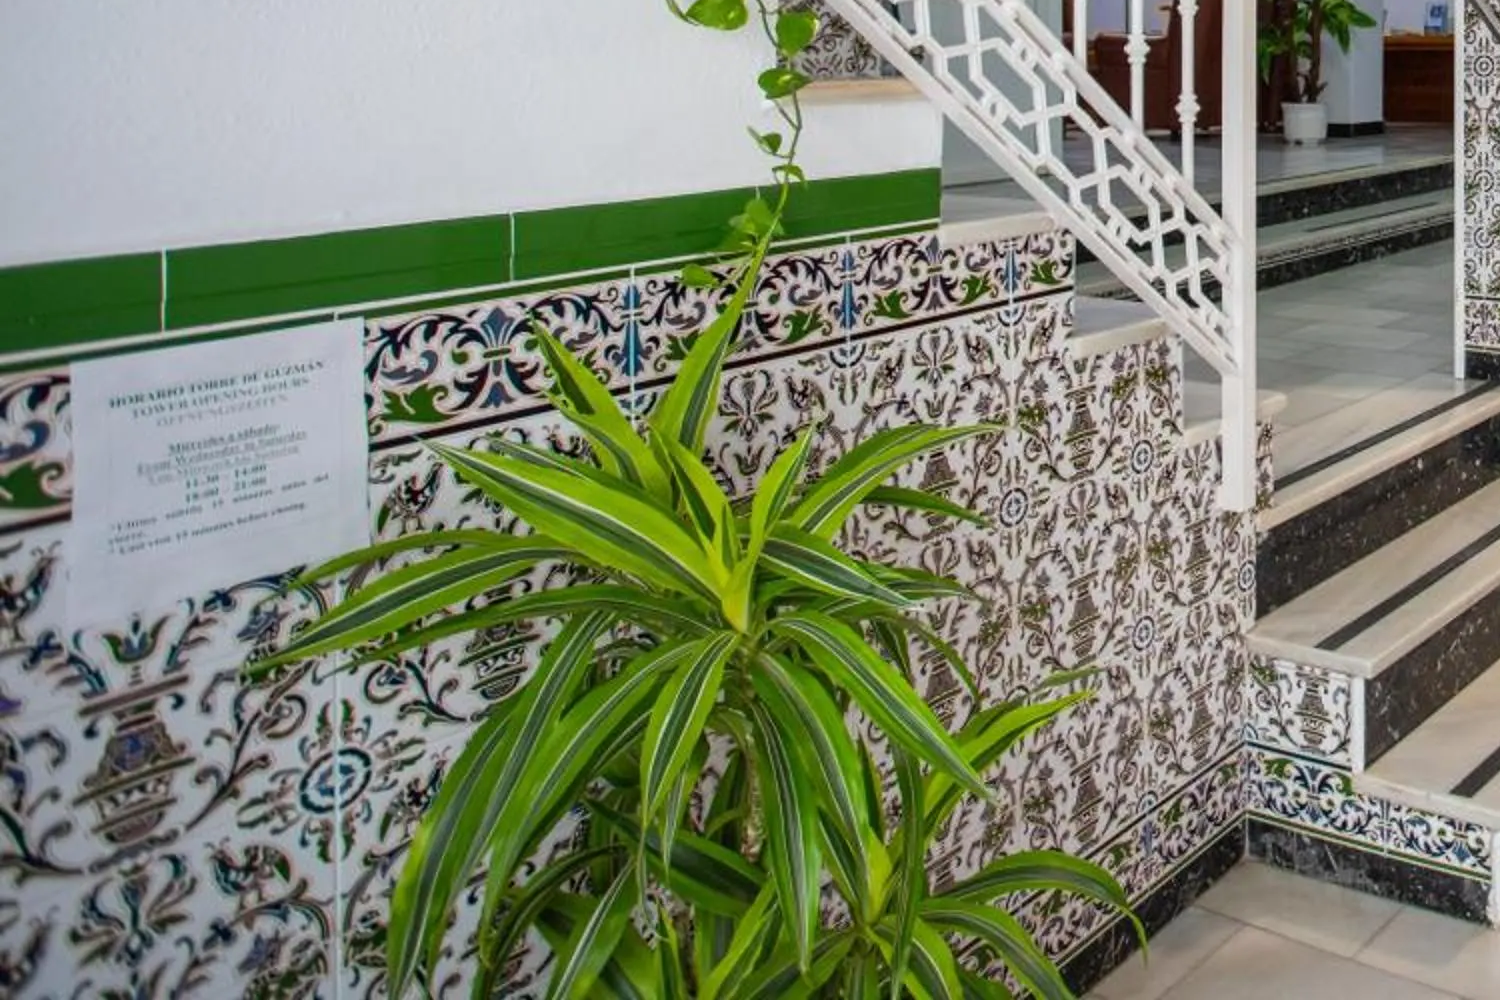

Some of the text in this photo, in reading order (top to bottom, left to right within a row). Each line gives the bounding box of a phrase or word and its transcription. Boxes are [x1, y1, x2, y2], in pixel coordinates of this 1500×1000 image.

[109, 385, 185, 408] HORARIO
[190, 376, 238, 393] TORRE
[242, 372, 258, 385] DE
[132, 377, 309, 419] TOWER OPENING HOURS
